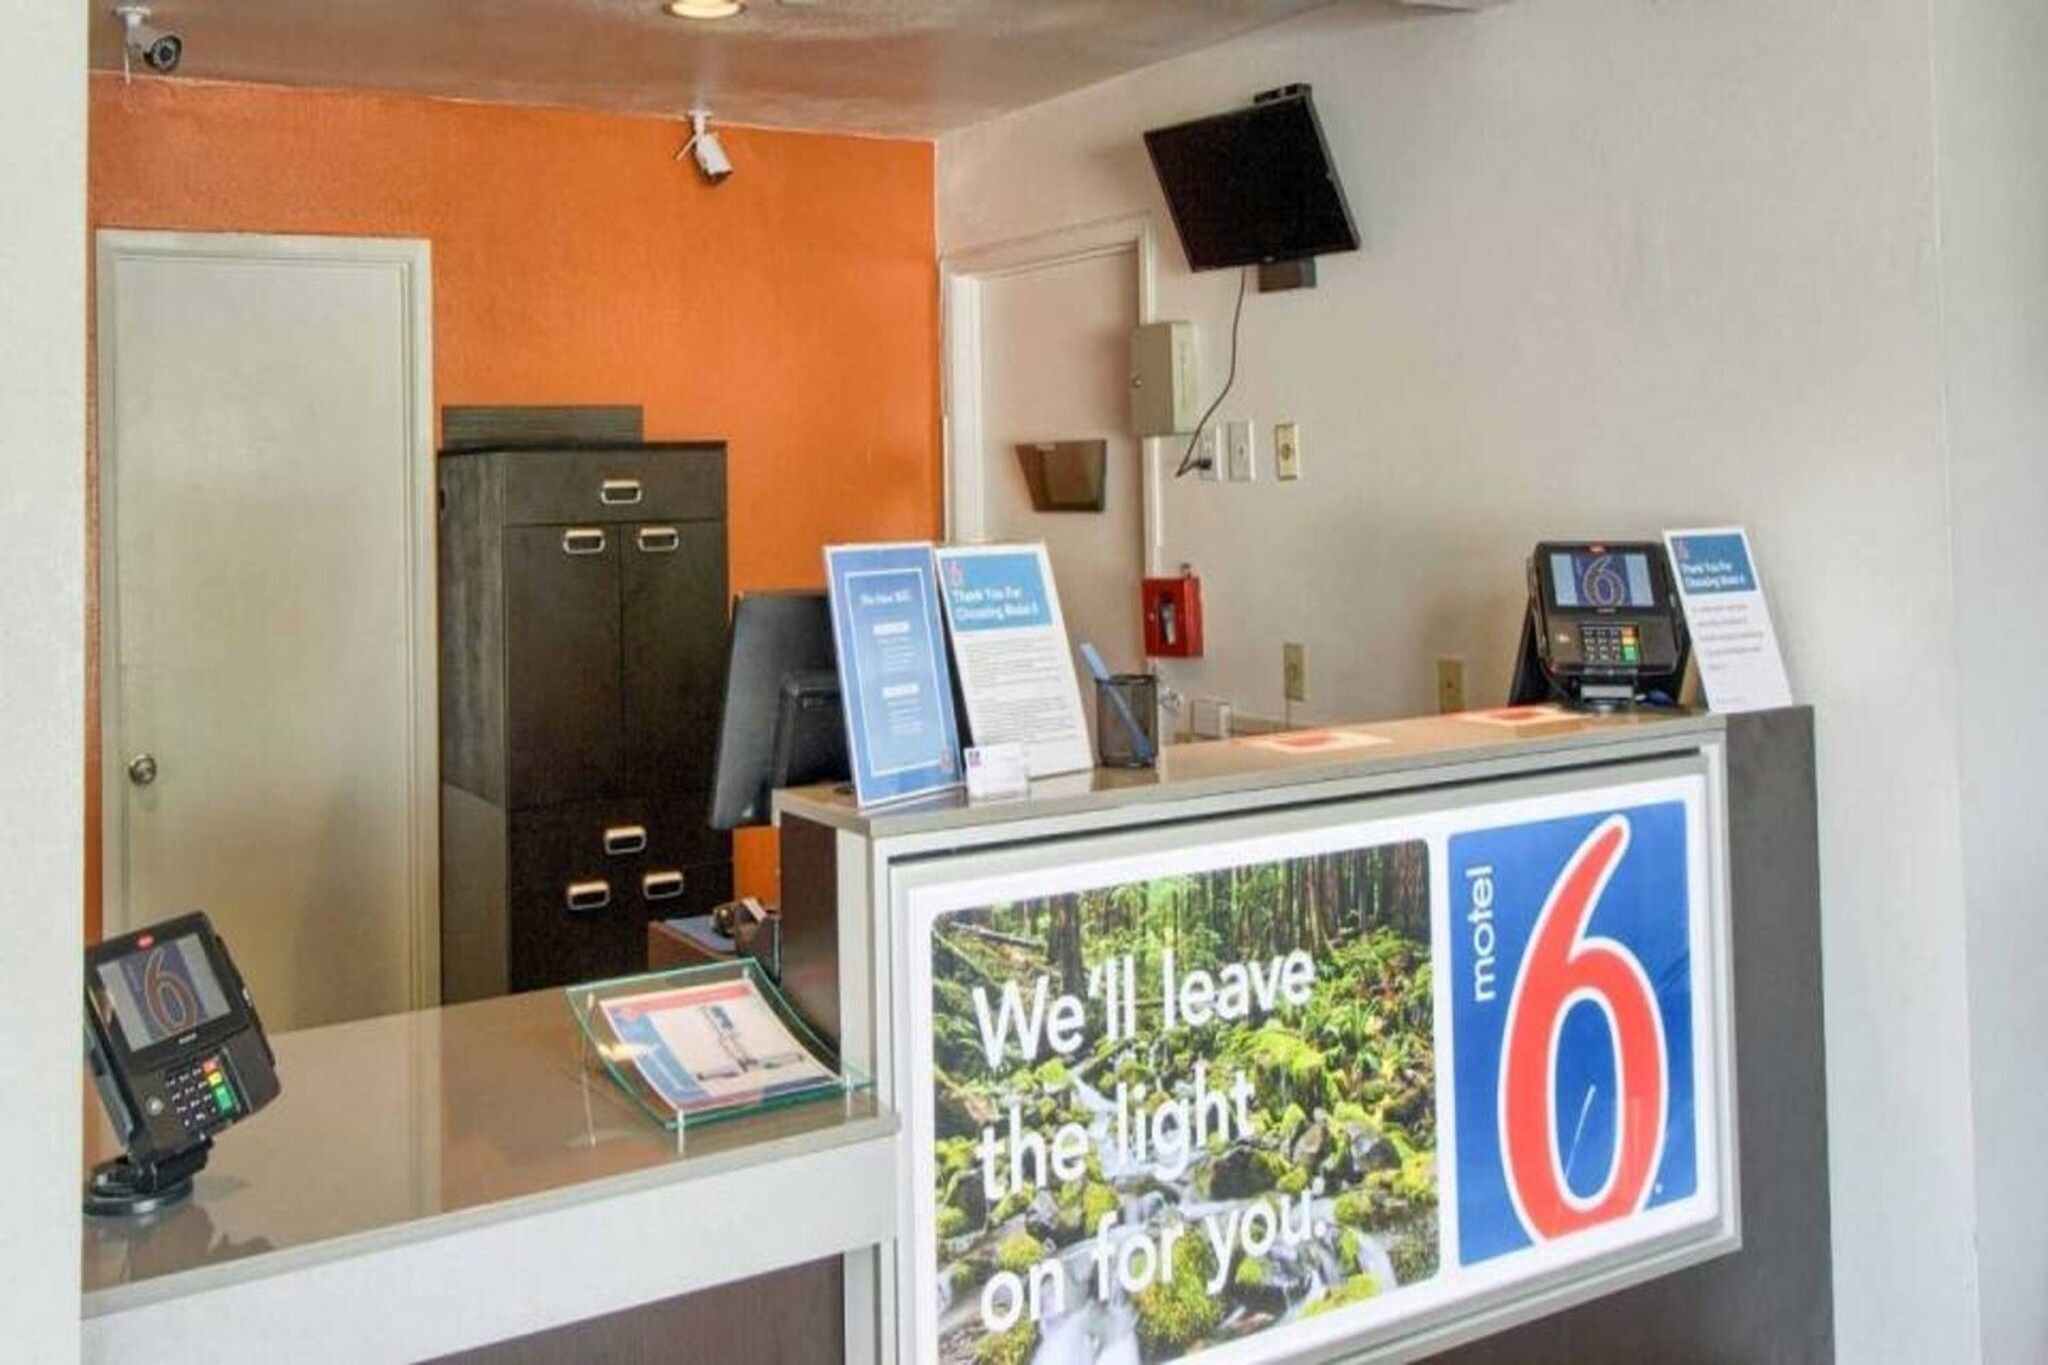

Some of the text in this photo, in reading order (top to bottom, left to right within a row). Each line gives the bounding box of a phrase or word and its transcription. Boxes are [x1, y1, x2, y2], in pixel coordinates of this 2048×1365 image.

[1583, 553, 1624, 610] 6
[145, 945, 197, 1037] 6
[972, 947, 1316, 1071] We'll leave
[1466, 813, 1669, 1247] motel 6
[975, 1060, 1256, 1201] the light
[980, 1187, 1327, 1332] on for you.
